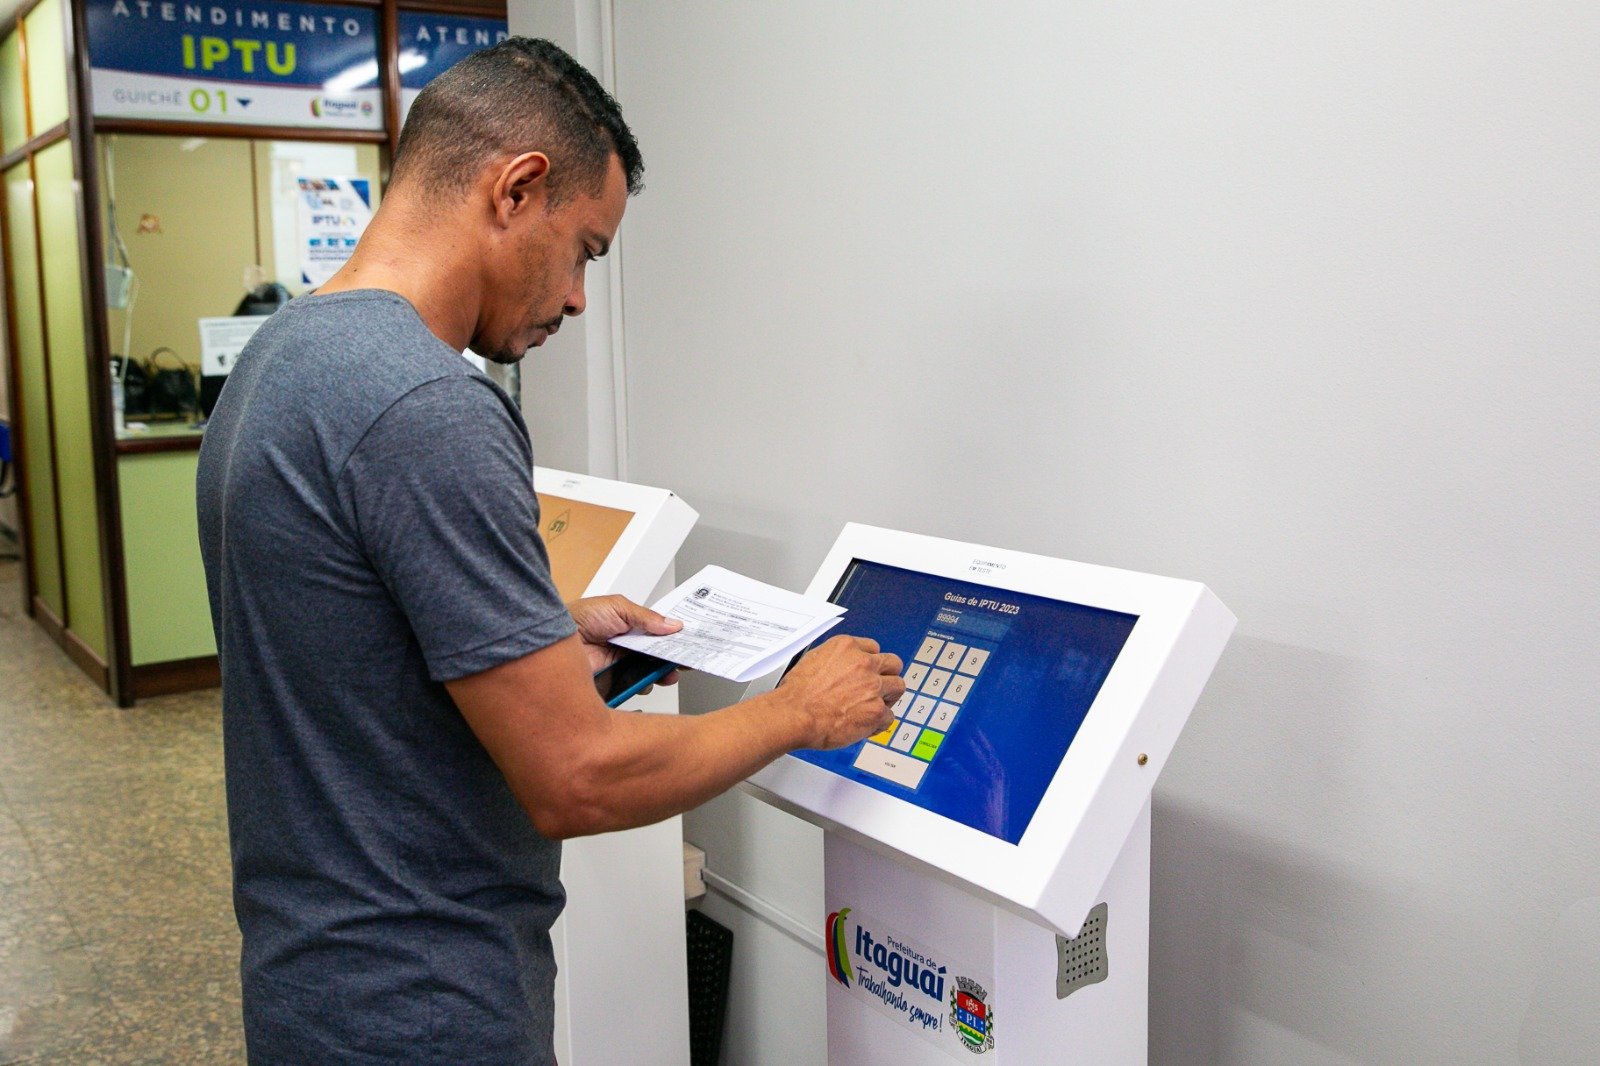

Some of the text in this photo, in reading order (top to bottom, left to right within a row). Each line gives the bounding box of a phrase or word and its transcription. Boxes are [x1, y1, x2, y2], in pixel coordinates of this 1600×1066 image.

[112, 0, 361, 37] ATENDIMENTO
[181, 34, 297, 76] IPTU
[190, 88, 226, 113] 01
[944, 591, 967, 604] Guias
[967, 597, 979, 607] de
[978, 598, 1001, 613] IPTU
[998, 603, 1021, 616] 2023
[926, 646, 978, 665] 7 8 9
[933, 678, 940, 687] 5
[955, 685, 962, 693] 6
[917, 705, 925, 714] 2
[940, 712, 947, 721] 3
[902, 733, 909, 741] 0
[855, 924, 947, 1002] Itaguaí
[887, 935, 937, 970] Prefeitura de
[856, 965, 943, 1033] Trabalhando sempre!
